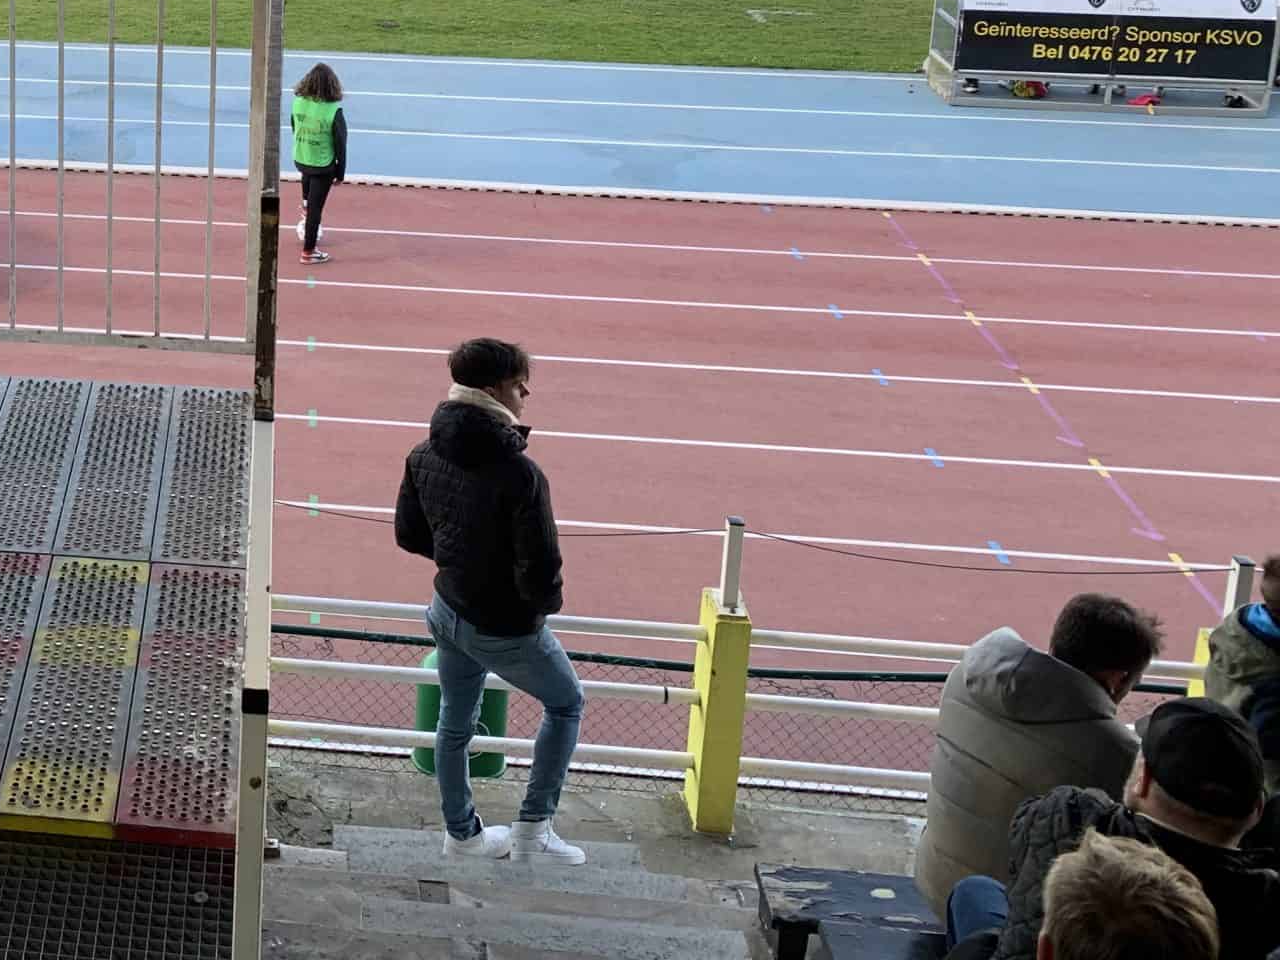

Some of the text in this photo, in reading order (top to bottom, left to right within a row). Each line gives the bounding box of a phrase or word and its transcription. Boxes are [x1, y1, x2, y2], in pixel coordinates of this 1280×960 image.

[974, 20, 1263, 46] Geïnteresseerd? Sponsor KSVO
[1032, 43, 1198, 64] Bel 0476 20 27 17
